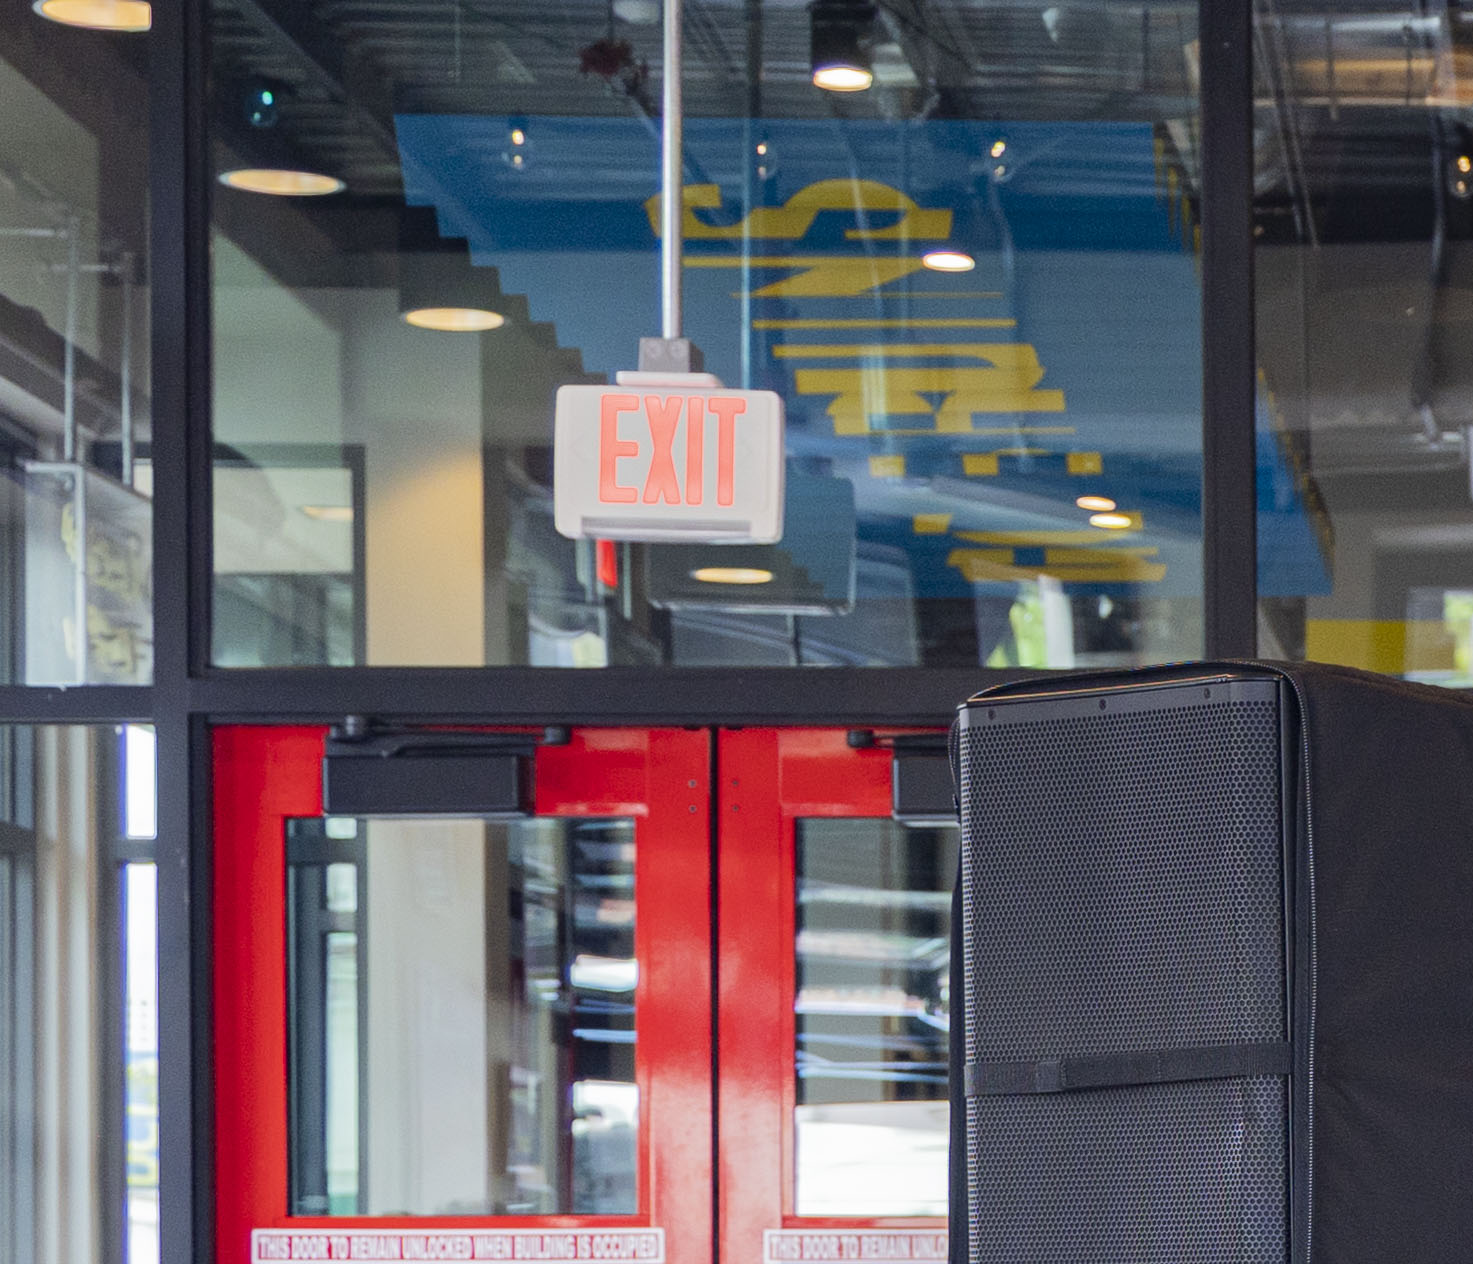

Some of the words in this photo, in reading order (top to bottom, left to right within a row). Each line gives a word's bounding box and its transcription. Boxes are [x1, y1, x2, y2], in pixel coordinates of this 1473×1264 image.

[599, 394, 747, 507] EXIT
[259, 1235, 289, 1260] THIS
[291, 1235, 330, 1260] DOOR
[331, 1235, 349, 1260] TO
[350, 1235, 401, 1260] REMAIN
[402, 1235, 472, 1260] UNLOCKED
[474, 1235, 513, 1260] WHEN
[514, 1235, 574, 1260] BUILDING
[577, 1235, 591, 1260] IS
[593, 1235, 658, 1260] OCCUPIED
[771, 1235, 801, 1260] THIS
[802, 1235, 840, 1260] DOOR
[841, 1235, 859, 1260] TO
[860, 1235, 911, 1260] REMAIN
[912, 1235, 948, 1260] UNLO
